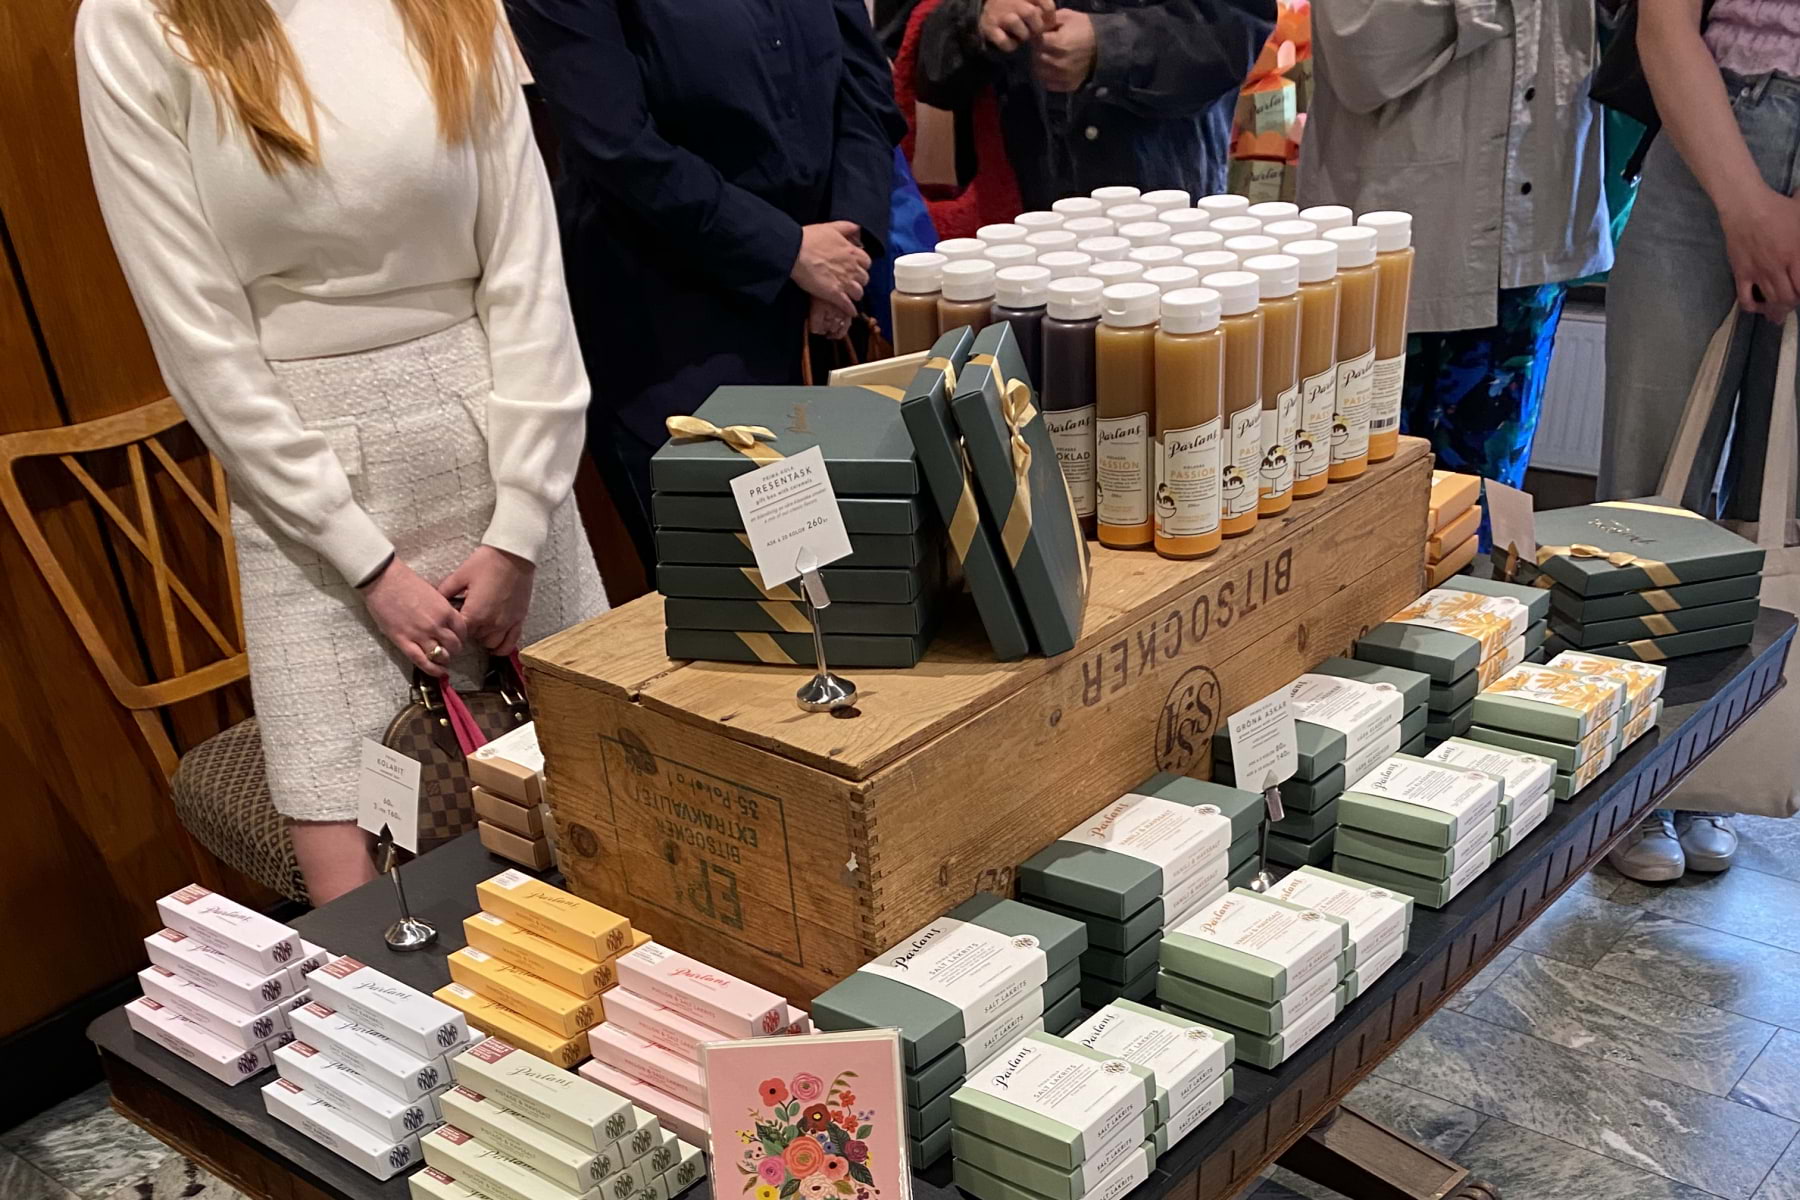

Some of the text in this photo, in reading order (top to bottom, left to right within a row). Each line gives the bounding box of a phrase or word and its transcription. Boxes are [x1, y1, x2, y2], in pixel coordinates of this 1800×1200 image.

[1047, 416, 1091, 434] Parlans
[1098, 424, 1142, 446] Parlans
[1056, 451, 1091, 461] OKLAD
[1169, 430, 1217, 458] Parlans
[1098, 459, 1140, 469] PASSION
[1170, 466, 1216, 479] PASSION
[749, 465, 813, 497] PRESENTASK
[1082, 547, 1293, 708] BITSOCKER
[1235, 701, 1288, 734] GRÖNA ASKAR
[377, 758, 404, 776] KOLABIT
[1372, 762, 1402, 792] Parlans
[1088, 802, 1129, 839] Parlans
[525, 891, 580, 909] Parlans
[1280, 876, 1303, 901] arlans
[200, 905, 253, 922] Parlans
[1201, 900, 1236, 935] Parlans
[892, 927, 944, 971] Parlans
[928, 942, 980, 976] SALT LAKRITS
[354, 980, 413, 1000] Parlans
[668, 966, 732, 989] Parlans
[984, 979, 1027, 1013] SALT LAKRITS
[984, 1015, 1024, 1049] SALT LAKRITS
[1080, 1012, 1116, 1049] Parlans
[1134, 1028, 1159, 1051] LAKRITS
[507, 1064, 574, 1090] Parlans
[993, 1046, 1034, 1089] Parlans
[1034, 1063, 1077, 1099] SALT LAKRITS
[1181, 1066, 1214, 1098] SALT LAKRITS
[1097, 1104, 1133, 1137] SALT LAKRITS
[1178, 1100, 1212, 1131] SALT LAKRITS
[1097, 1137, 1132, 1171] SALT LAKRITS
[1109, 1174, 1134, 1195] LAKRITS
